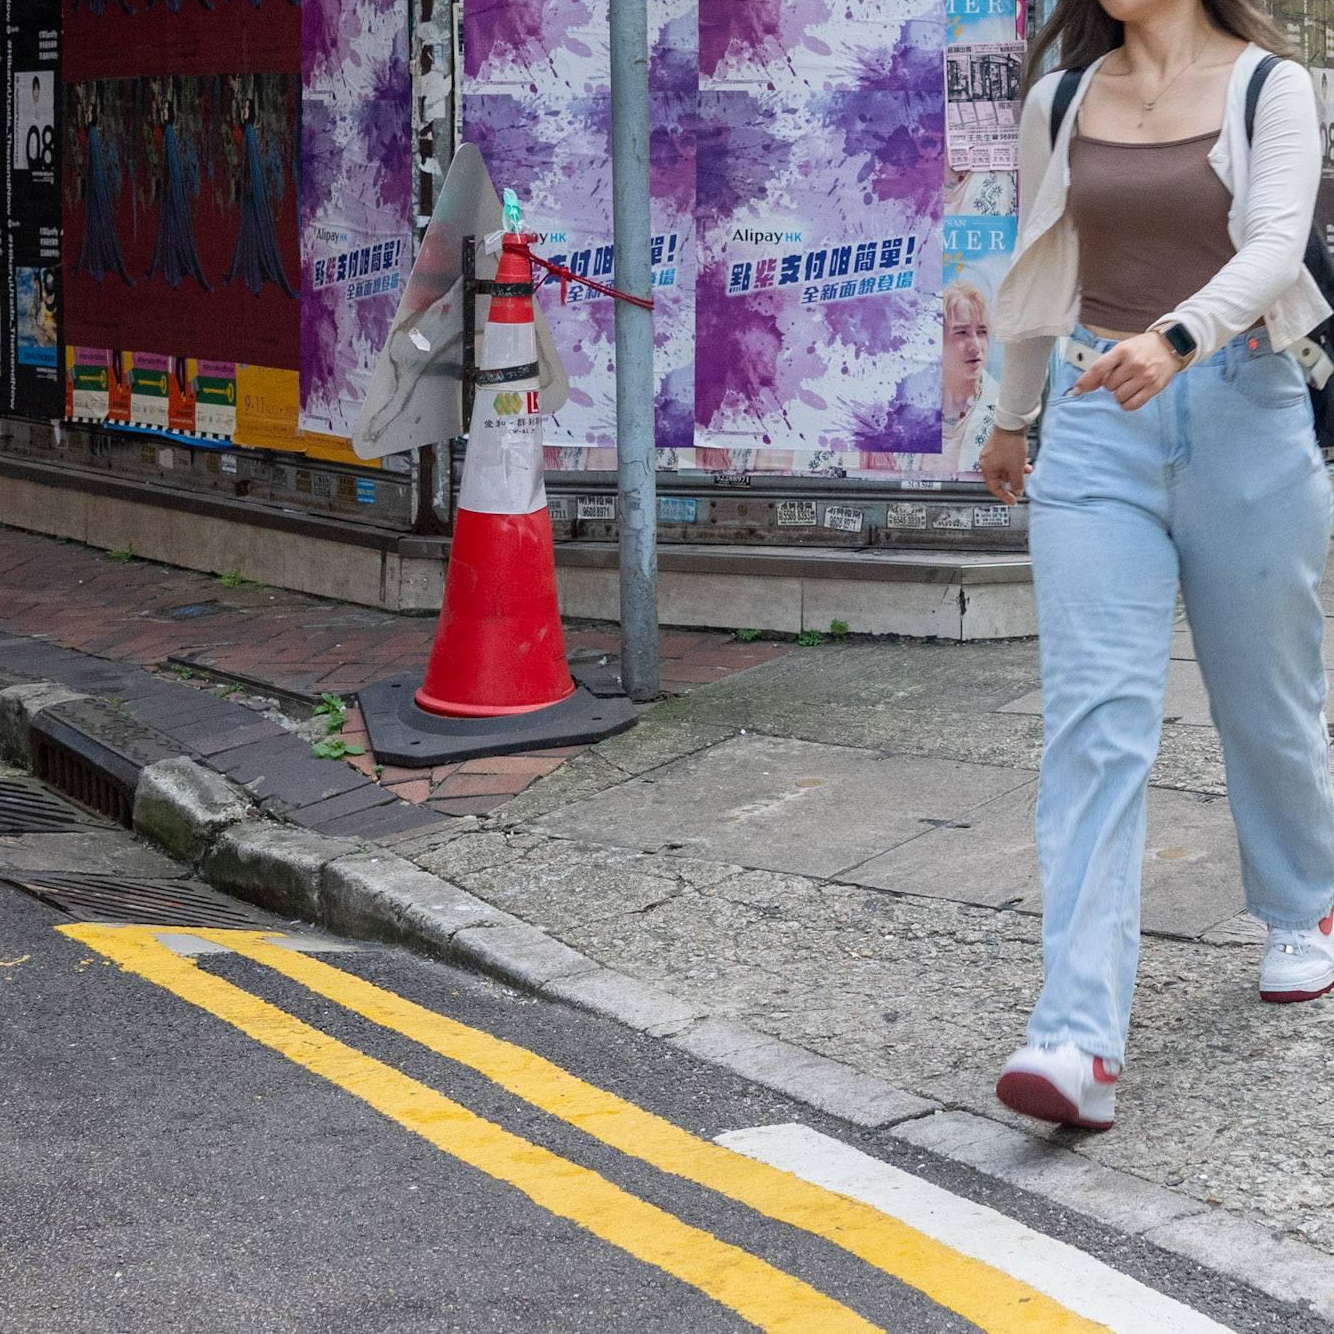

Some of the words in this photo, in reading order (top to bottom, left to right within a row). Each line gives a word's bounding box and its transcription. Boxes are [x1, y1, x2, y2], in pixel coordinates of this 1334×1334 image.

[26, 125, 55, 171] 08
[800, 269, 914, 305] 全新面貌登場
